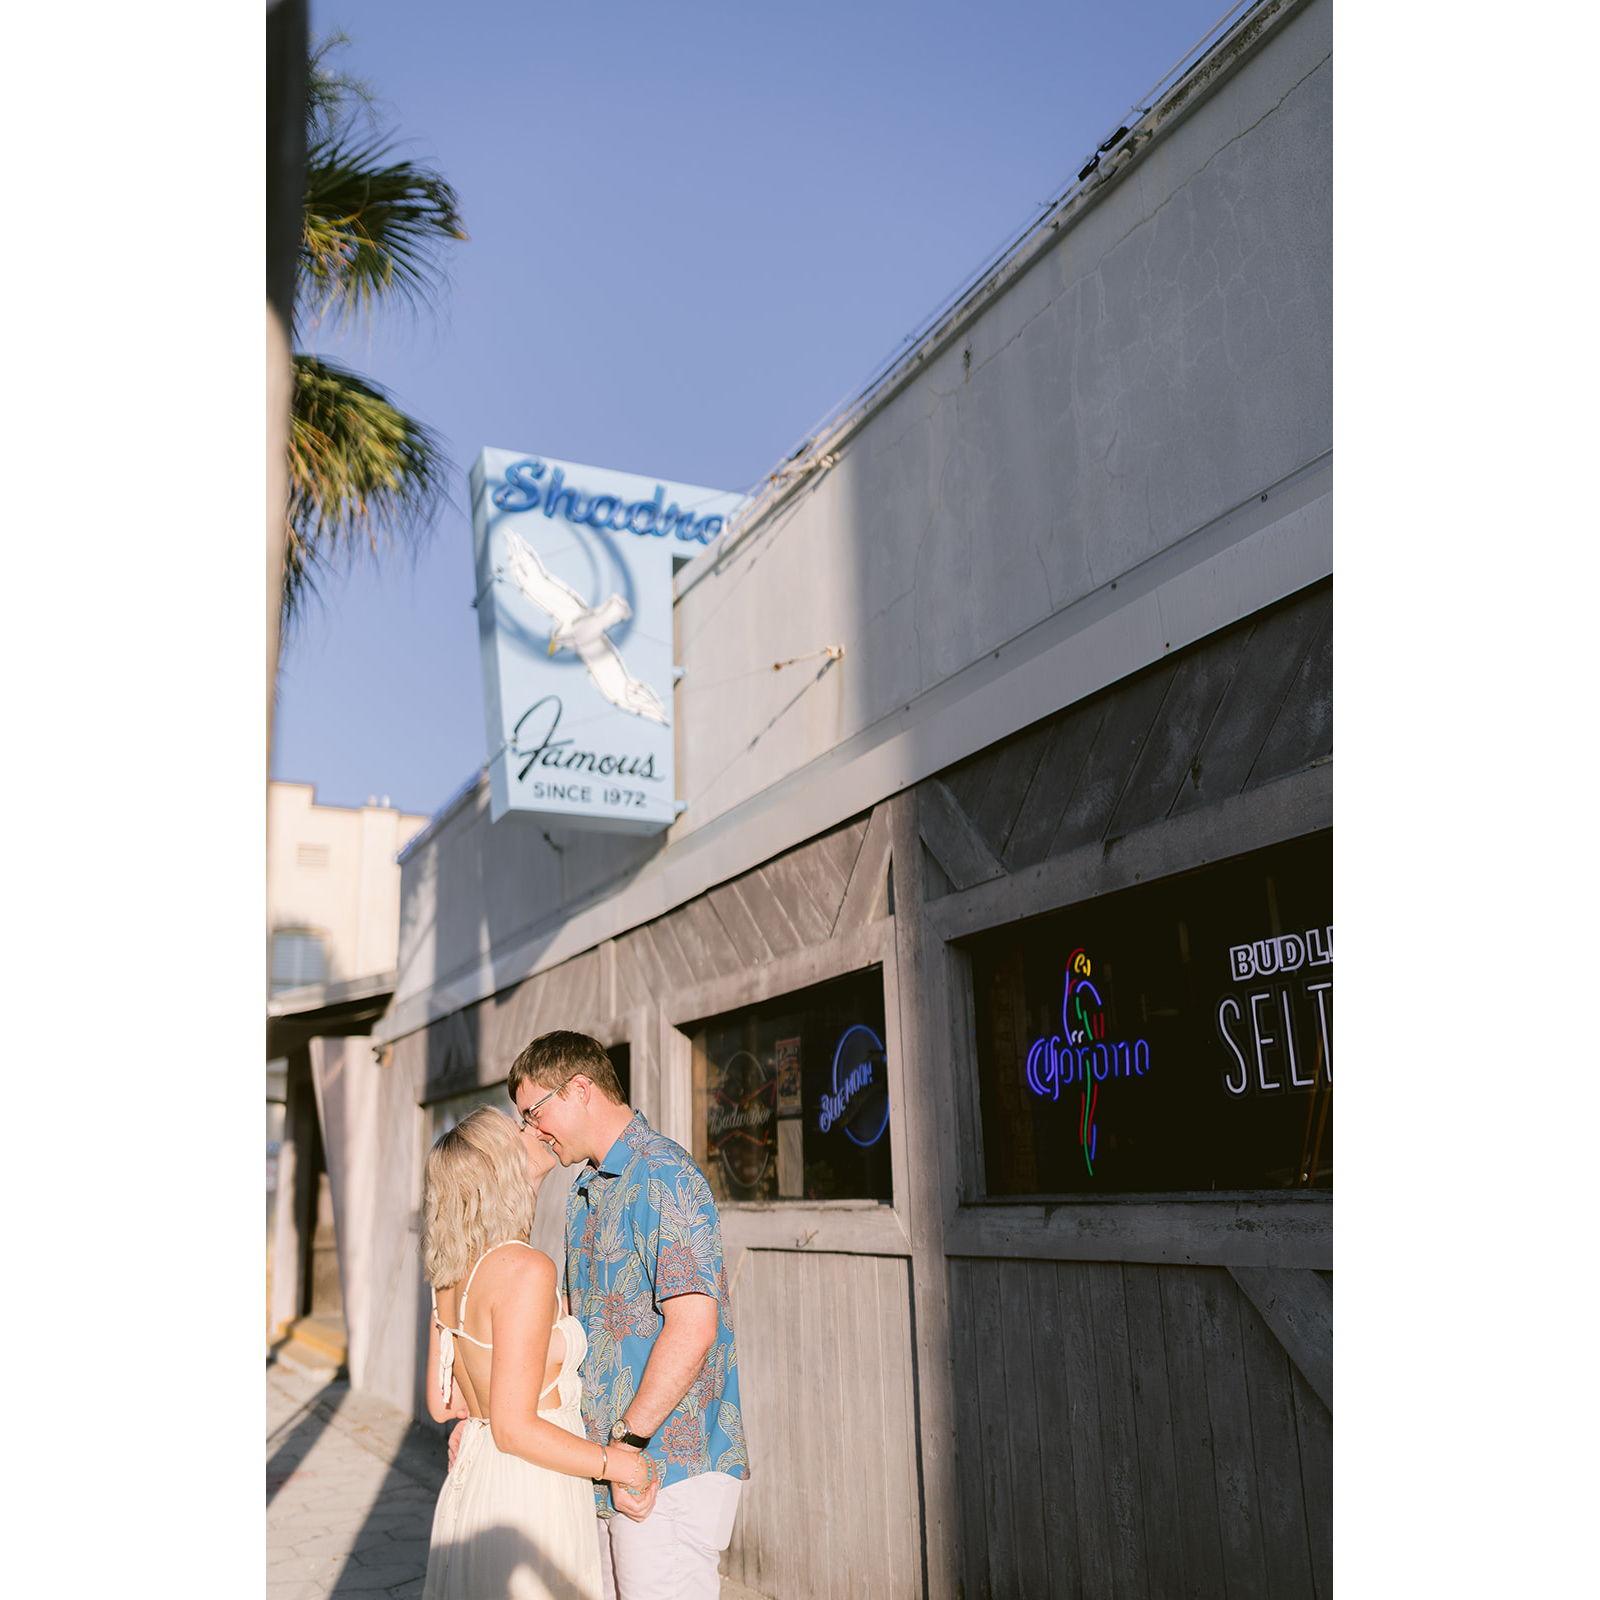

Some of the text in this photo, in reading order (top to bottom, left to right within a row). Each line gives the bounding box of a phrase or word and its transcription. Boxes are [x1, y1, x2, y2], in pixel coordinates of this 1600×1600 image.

[513, 694, 665, 782] Famous
[534, 783, 647, 808] SINCE 1972
[1026, 1035, 1150, 1101] Corona
[1217, 982, 1333, 1094] SELT
